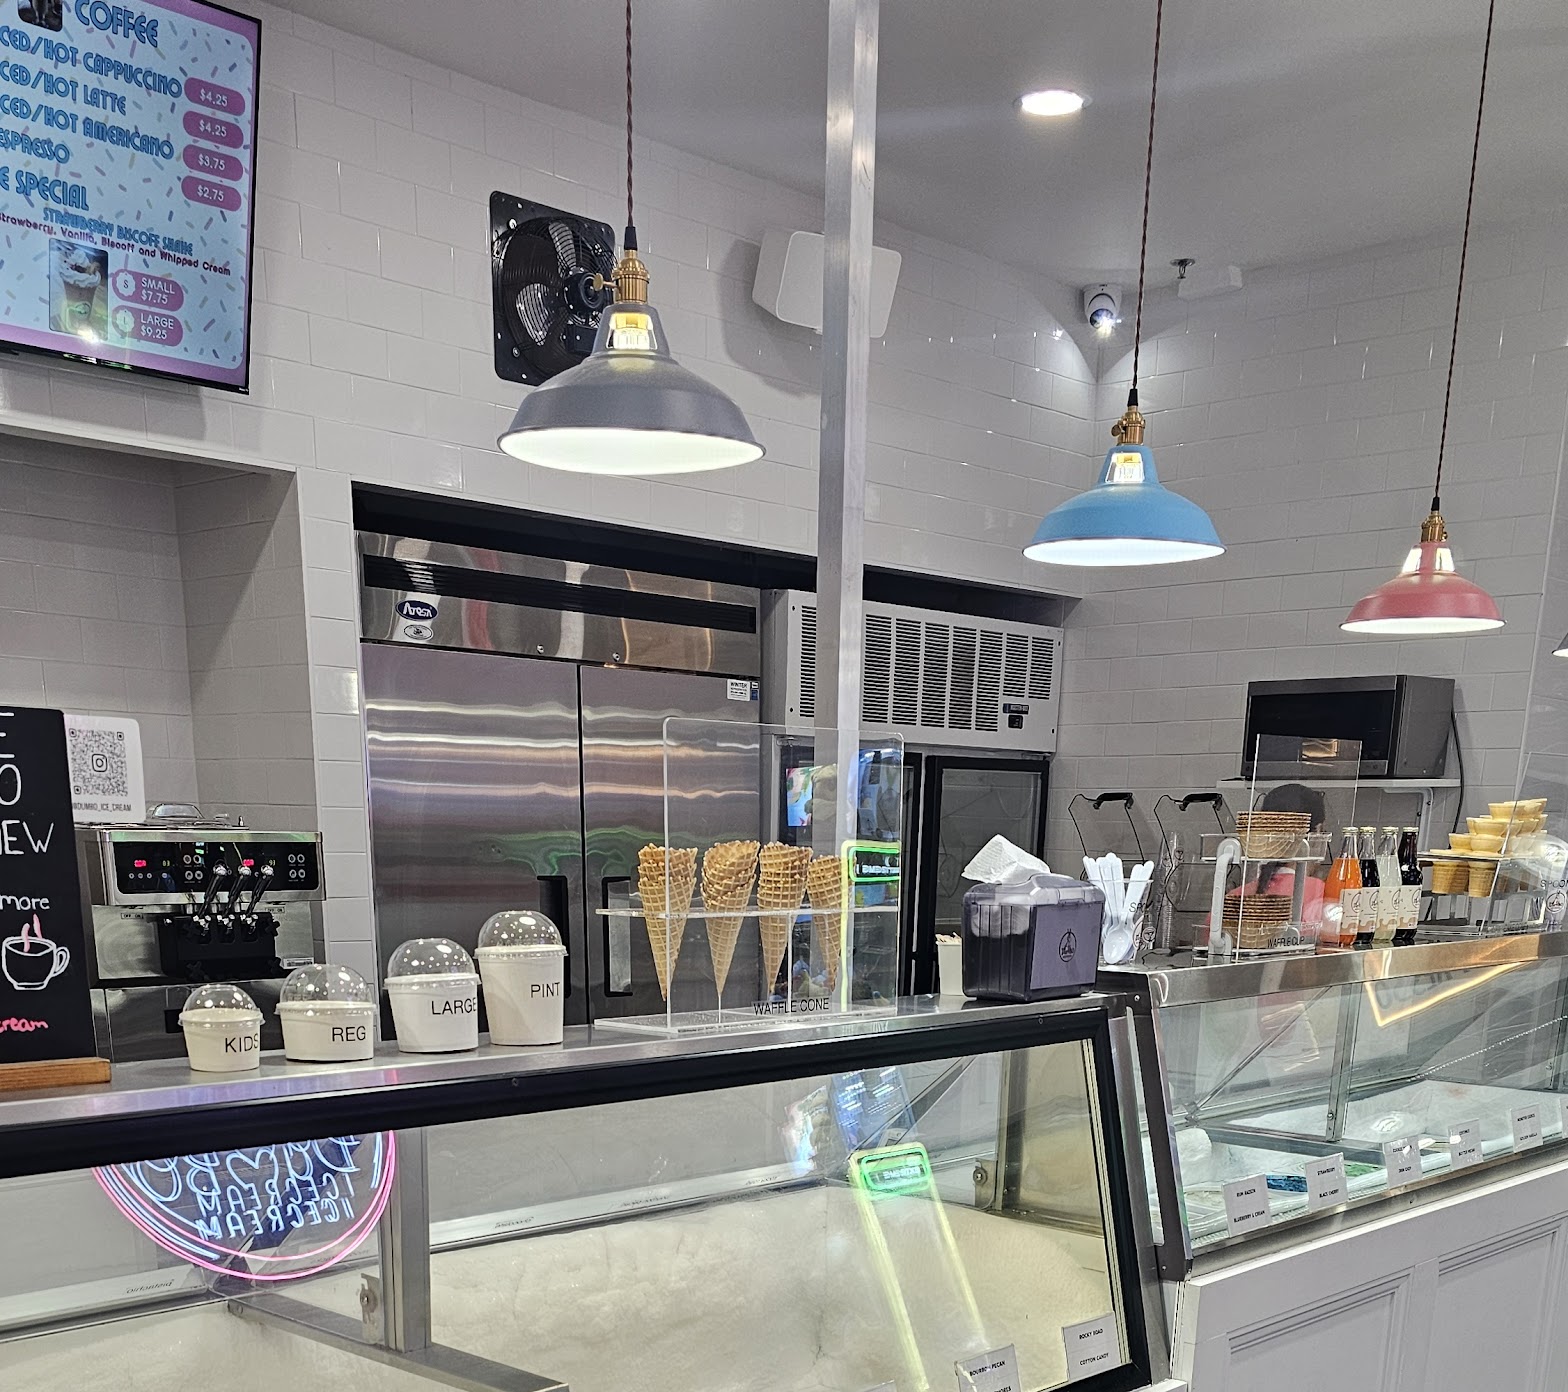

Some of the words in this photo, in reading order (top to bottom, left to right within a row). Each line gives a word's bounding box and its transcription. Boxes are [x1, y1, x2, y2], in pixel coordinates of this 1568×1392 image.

[75, 0, 158, 47] COFFEE
[83, 52, 182, 98] CAPPUCCINO
[83, 84, 126, 115] LATTE
[200, 88, 228, 107] $4.25
[82, 116, 174, 159] AMERICANO
[199, 119, 227, 138] $4.25
[198, 153, 225, 170] $3.75
[15, 169, 89, 211] SPECIAL
[197, 185, 224, 202] $2.75
[0, 212, 57, 236] trawberry,
[139, 247, 156, 257] and
[160, 250, 198, 268] Whipped
[203, 261, 231, 276] Cream
[117, 225, 160, 248] BISCOFF
[141, 278, 175, 294] SMALL
[141, 291, 168, 304] $7.75
[140, 313, 174, 329] LARGE
[140, 326, 167, 339] $9.25
[531, 982, 560, 998] PINT
[432, 997, 476, 1016] LARGE
[754, 1001, 797, 1015] WAFFLE
[800, 998, 829, 1011] CONE
[225, 1033, 259, 1053] KIDS
[332, 1026, 366, 1042] REG
[992, 1360, 1006, 1369] PECAN
